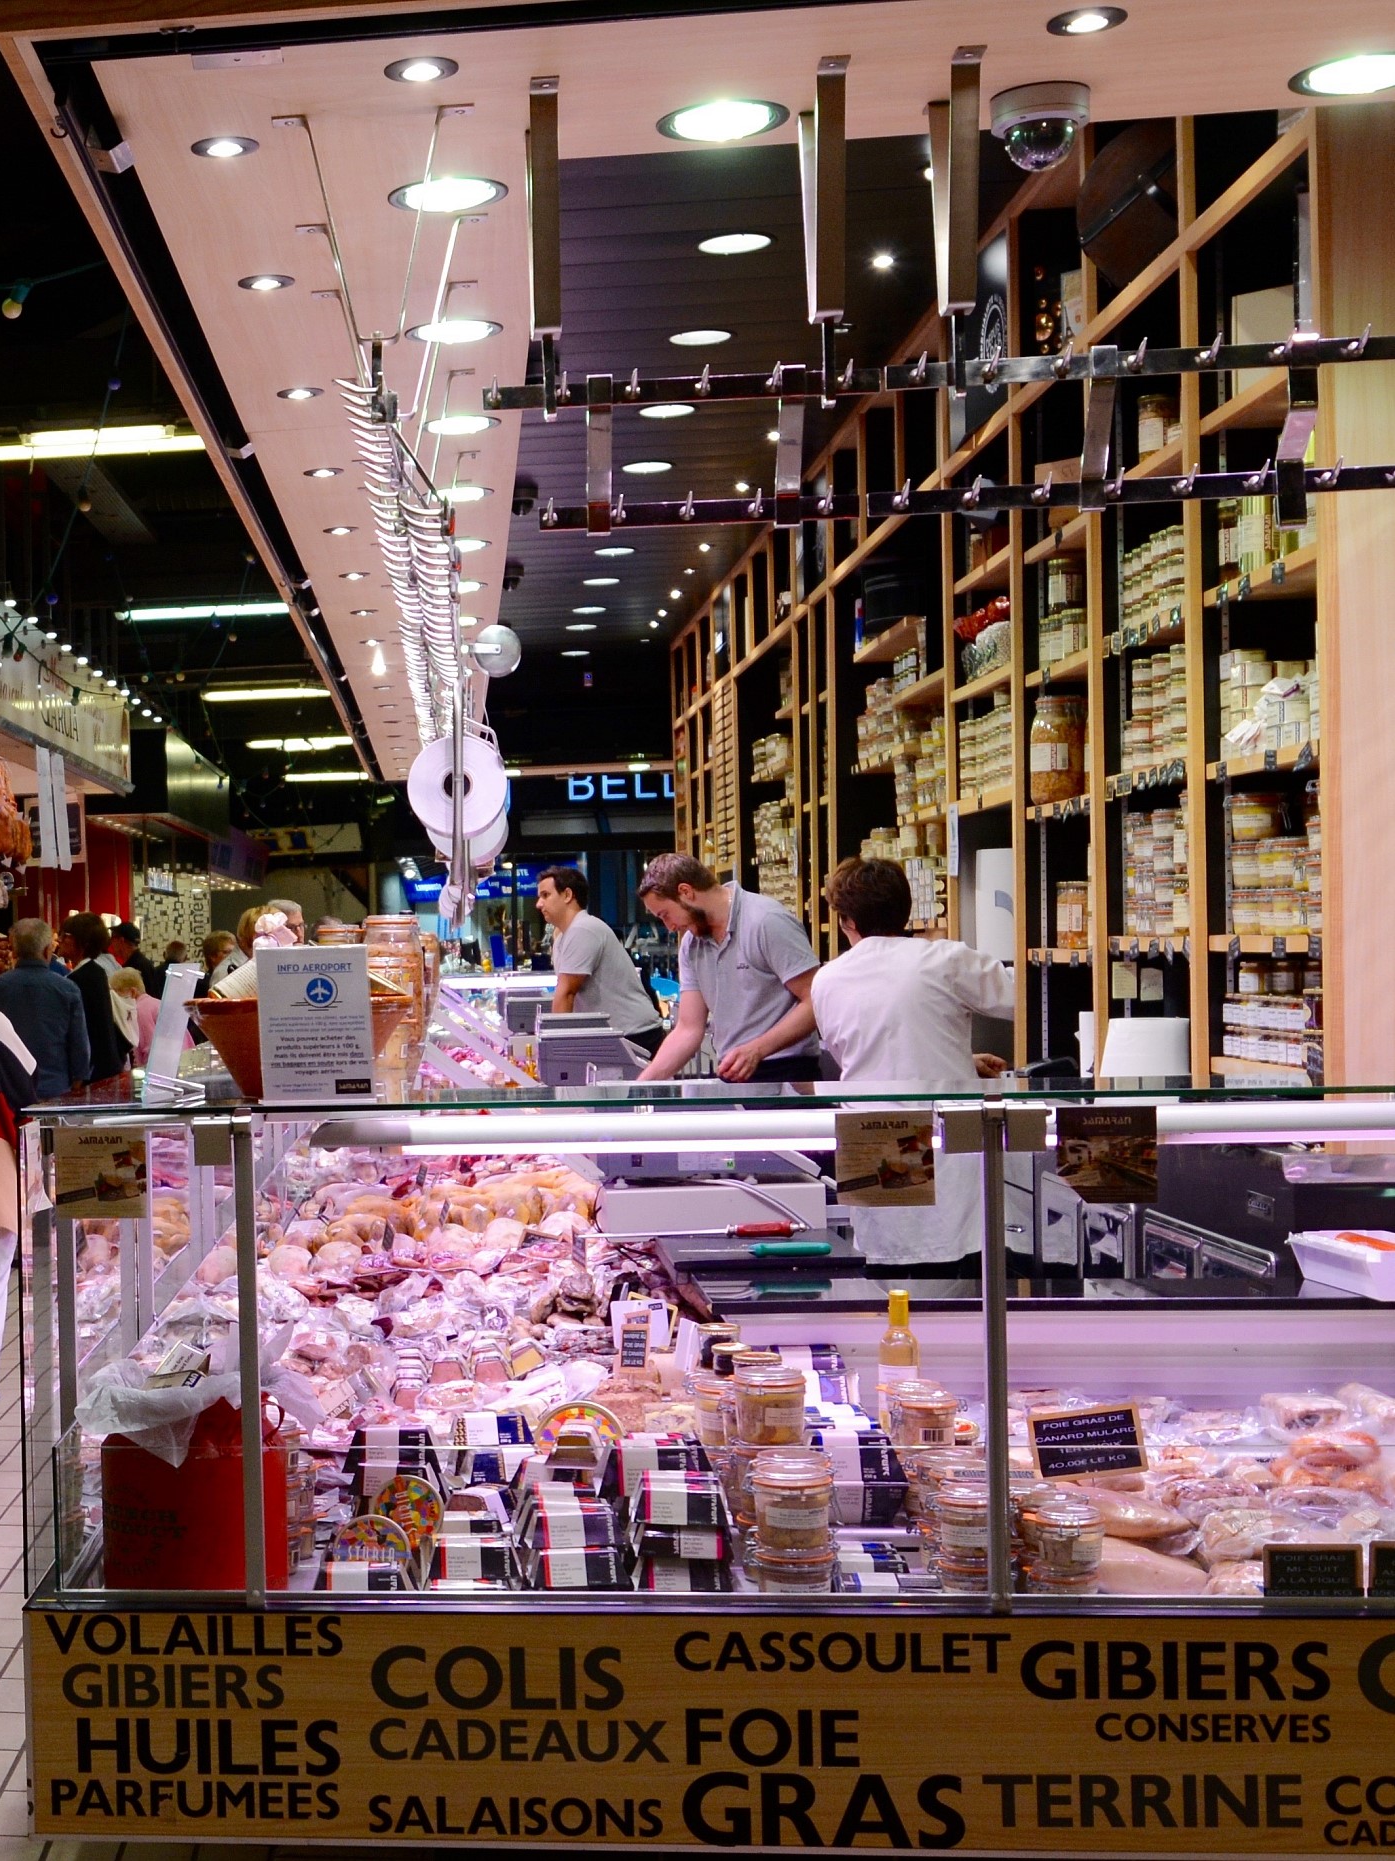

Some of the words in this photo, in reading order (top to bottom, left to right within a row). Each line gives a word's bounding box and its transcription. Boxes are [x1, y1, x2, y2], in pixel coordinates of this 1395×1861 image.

[277, 963, 300, 972] INFO
[302, 962, 352, 972] AEROPORT
[275, 1043, 301, 1051] produits
[1036, 1432, 1084, 1443] CANARD
[1086, 1426, 1137, 1438] MULARD
[1042, 1422, 1070, 1431] FOIE
[1072, 1417, 1106, 1427] GRAS
[1108, 1414, 1125, 1422] DE
[879, 1438, 891, 1477] SAMARAN
[1109, 1454, 1126, 1462] KG
[45, 1614, 343, 1656] VOLAILLES
[673, 1631, 1011, 1675] CASSOULET
[61, 1662, 285, 1709] GIBIERS
[370, 1645, 625, 1712] COLIS
[1020, 1639, 1331, 1702] GIBIERS
[76, 1718, 342, 1776] HUILES
[369, 1718, 671, 1763] CADEAUX
[684, 1708, 861, 1769] FOIE
[1095, 1712, 1332, 1744] CONSERVES
[50, 1779, 341, 1820] PARFUMEES
[368, 1795, 664, 1838] SALAISONS
[681, 1771, 966, 1850] GRAS
[981, 1773, 1303, 1829] TERRINE
